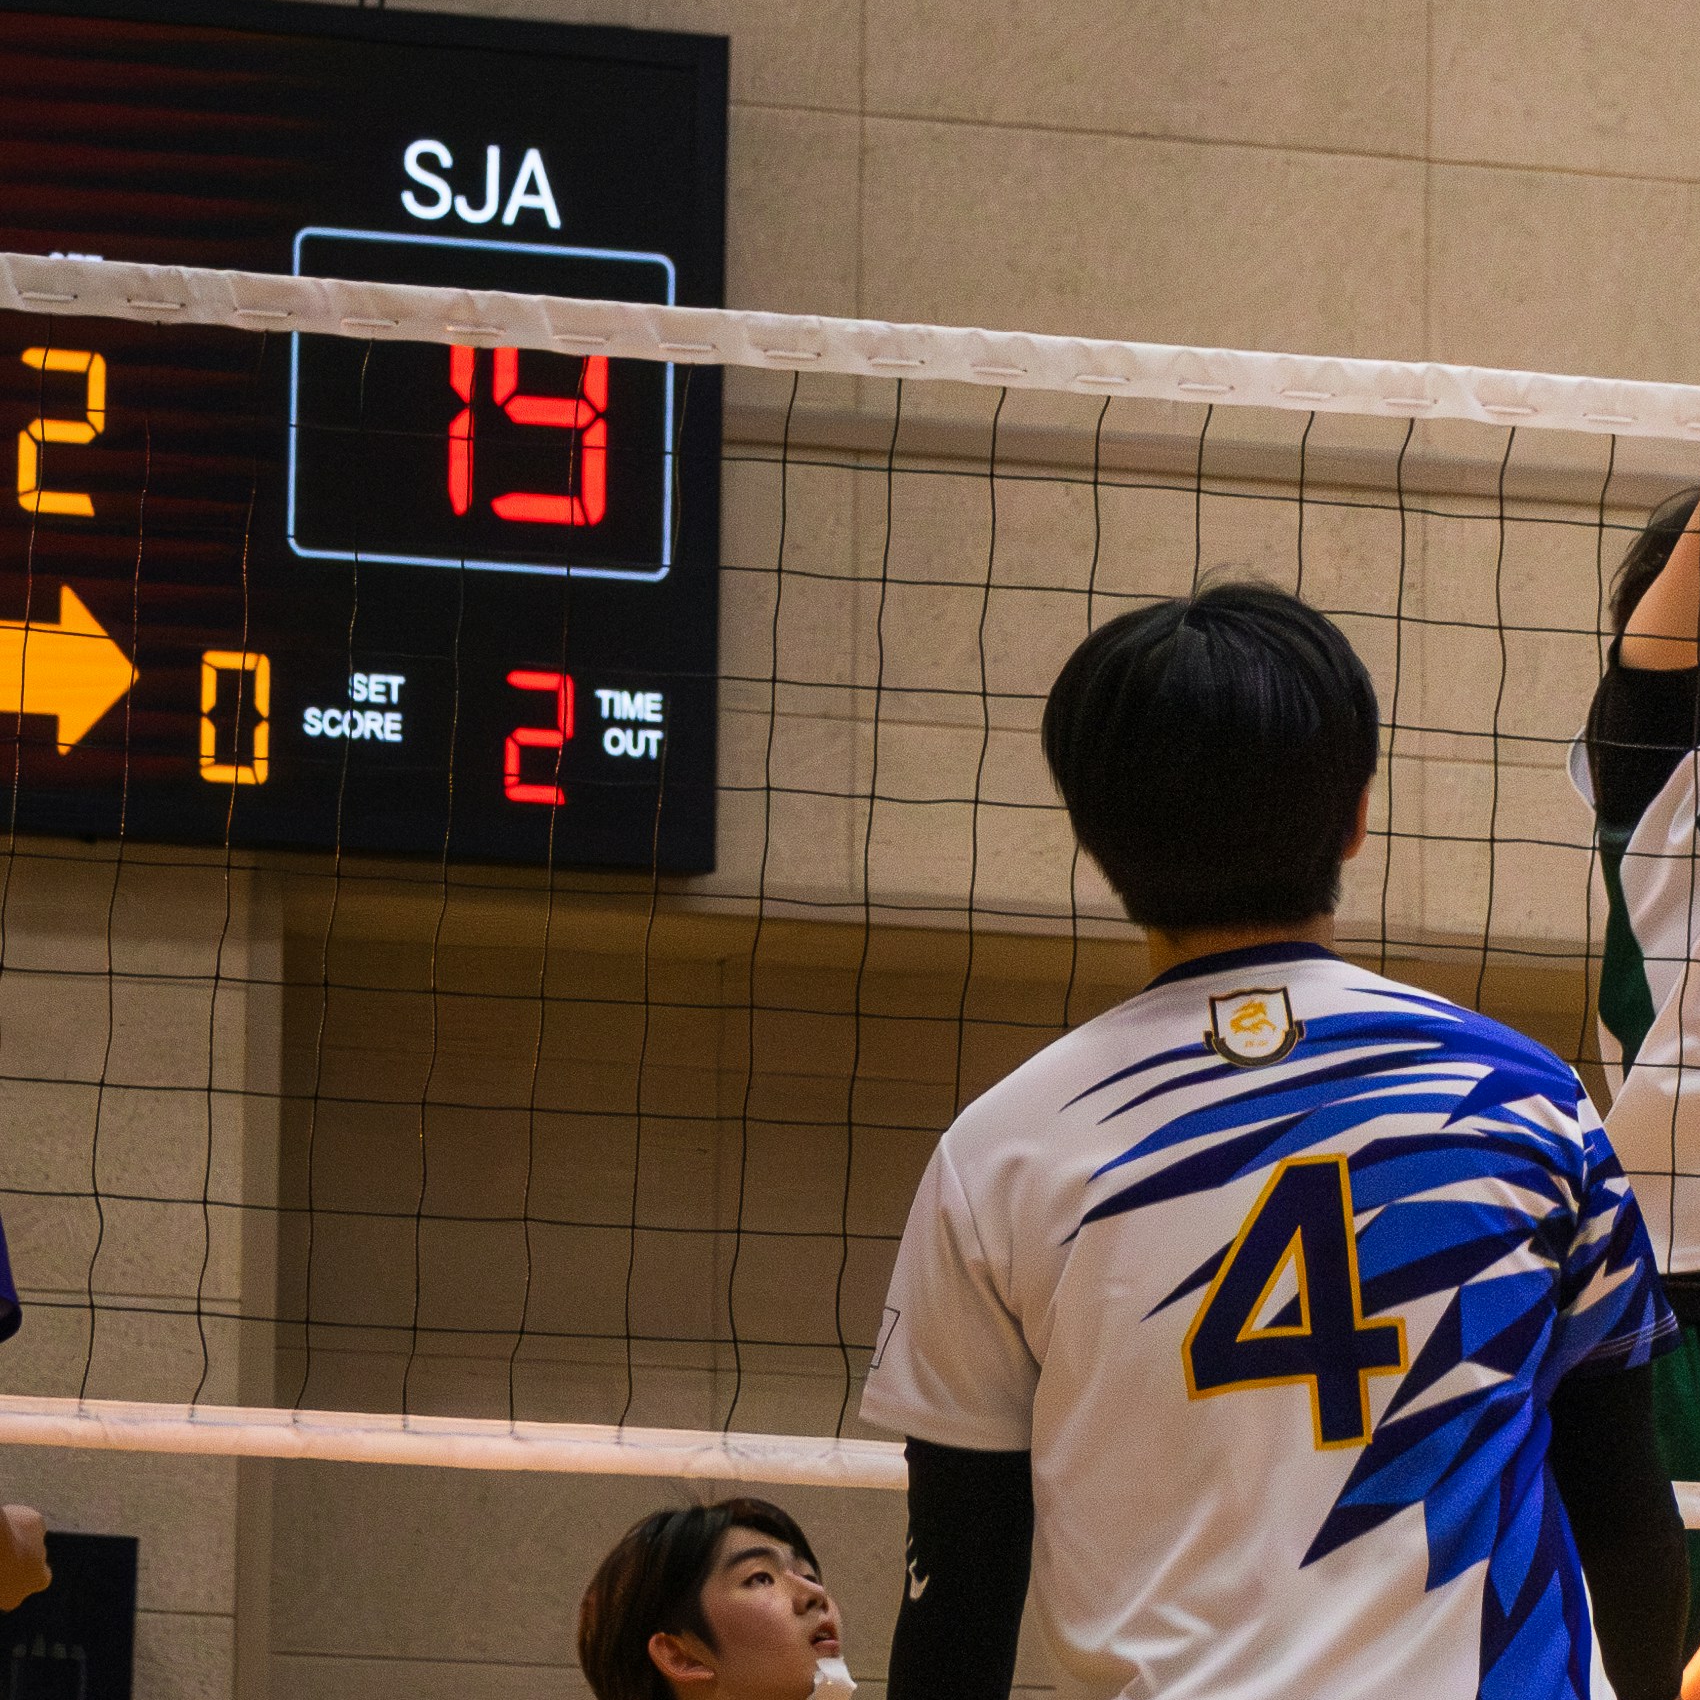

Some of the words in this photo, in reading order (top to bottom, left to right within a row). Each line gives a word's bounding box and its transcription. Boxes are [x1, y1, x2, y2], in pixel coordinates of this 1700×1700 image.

[401, 139, 561, 229] SJA
[18, 347, 107, 517] 2
[448, 344, 609, 526] 19
[200, 650, 271, 785] 0
[303, 706, 403, 742] SCORE
[349, 672, 406, 704] SET
[503, 669, 575, 806] 2
[594, 689, 663, 722] TIME
[602, 727, 664, 760] OUT
[1181, 1153, 1410, 1451] 4
